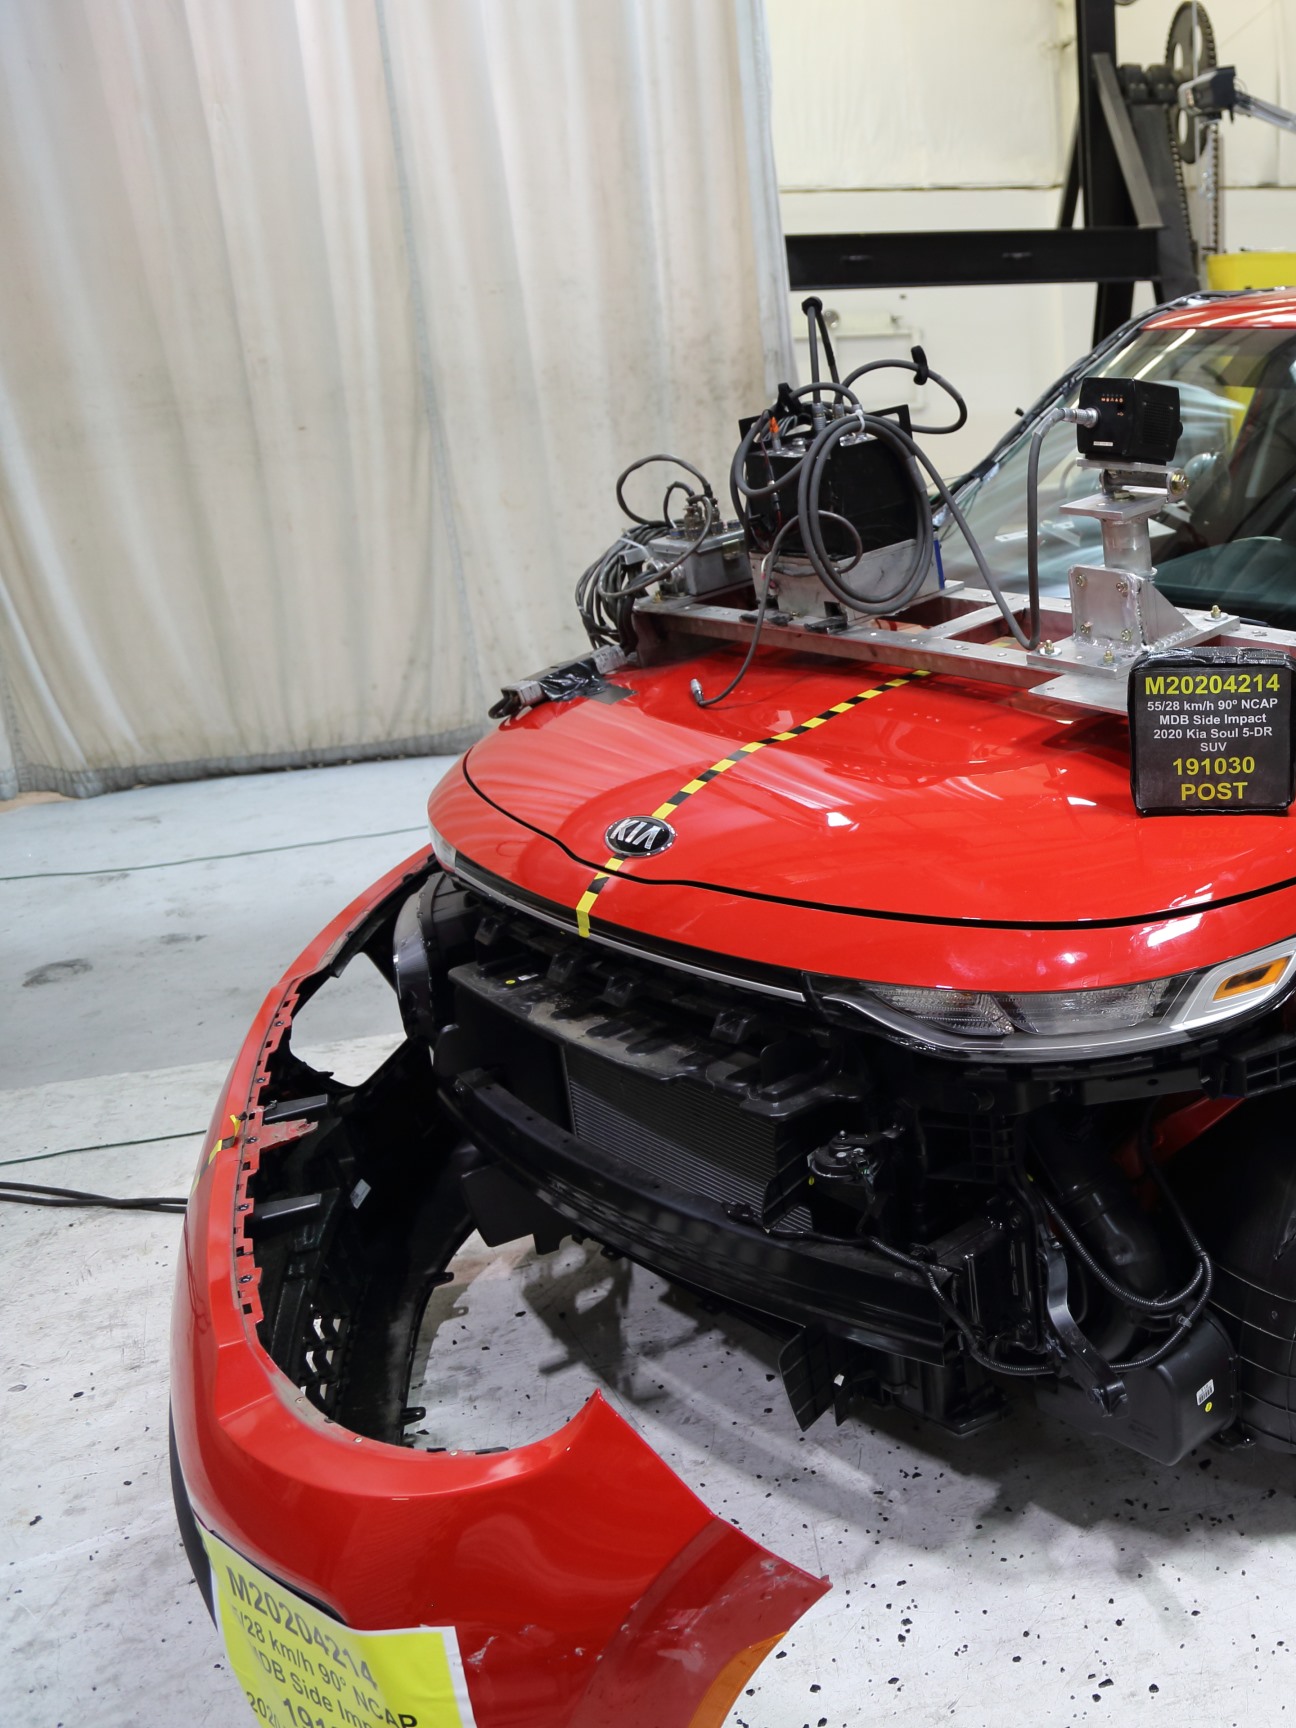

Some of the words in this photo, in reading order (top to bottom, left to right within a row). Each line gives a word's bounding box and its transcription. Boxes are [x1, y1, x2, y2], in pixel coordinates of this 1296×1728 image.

[1145, 674, 1280, 695] M20204214
[1147, 701, 1180, 712] 55/28
[1183, 700, 1214, 711] km/h
[1241, 698, 1278, 709] NCAP
[1159, 714, 1189, 725] MDB
[1193, 713, 1221, 725] Side
[1224, 713, 1267, 726] Impact
[1153, 729, 1183, 739] 2020
[1186, 728, 1207, 739] Kia
[1210, 727, 1239, 739] Soul
[1242, 726, 1273, 738] 5-DR
[1200, 742, 1227, 752] SUV
[1172, 756, 1255, 776] 191030
[1181, 781, 1248, 801] POST
[610, 818, 662, 850] KIA
[225, 1565, 378, 1691] M20204214
[268, 1630, 315, 1676] km/h
[290, 1671, 334, 1713] Side
